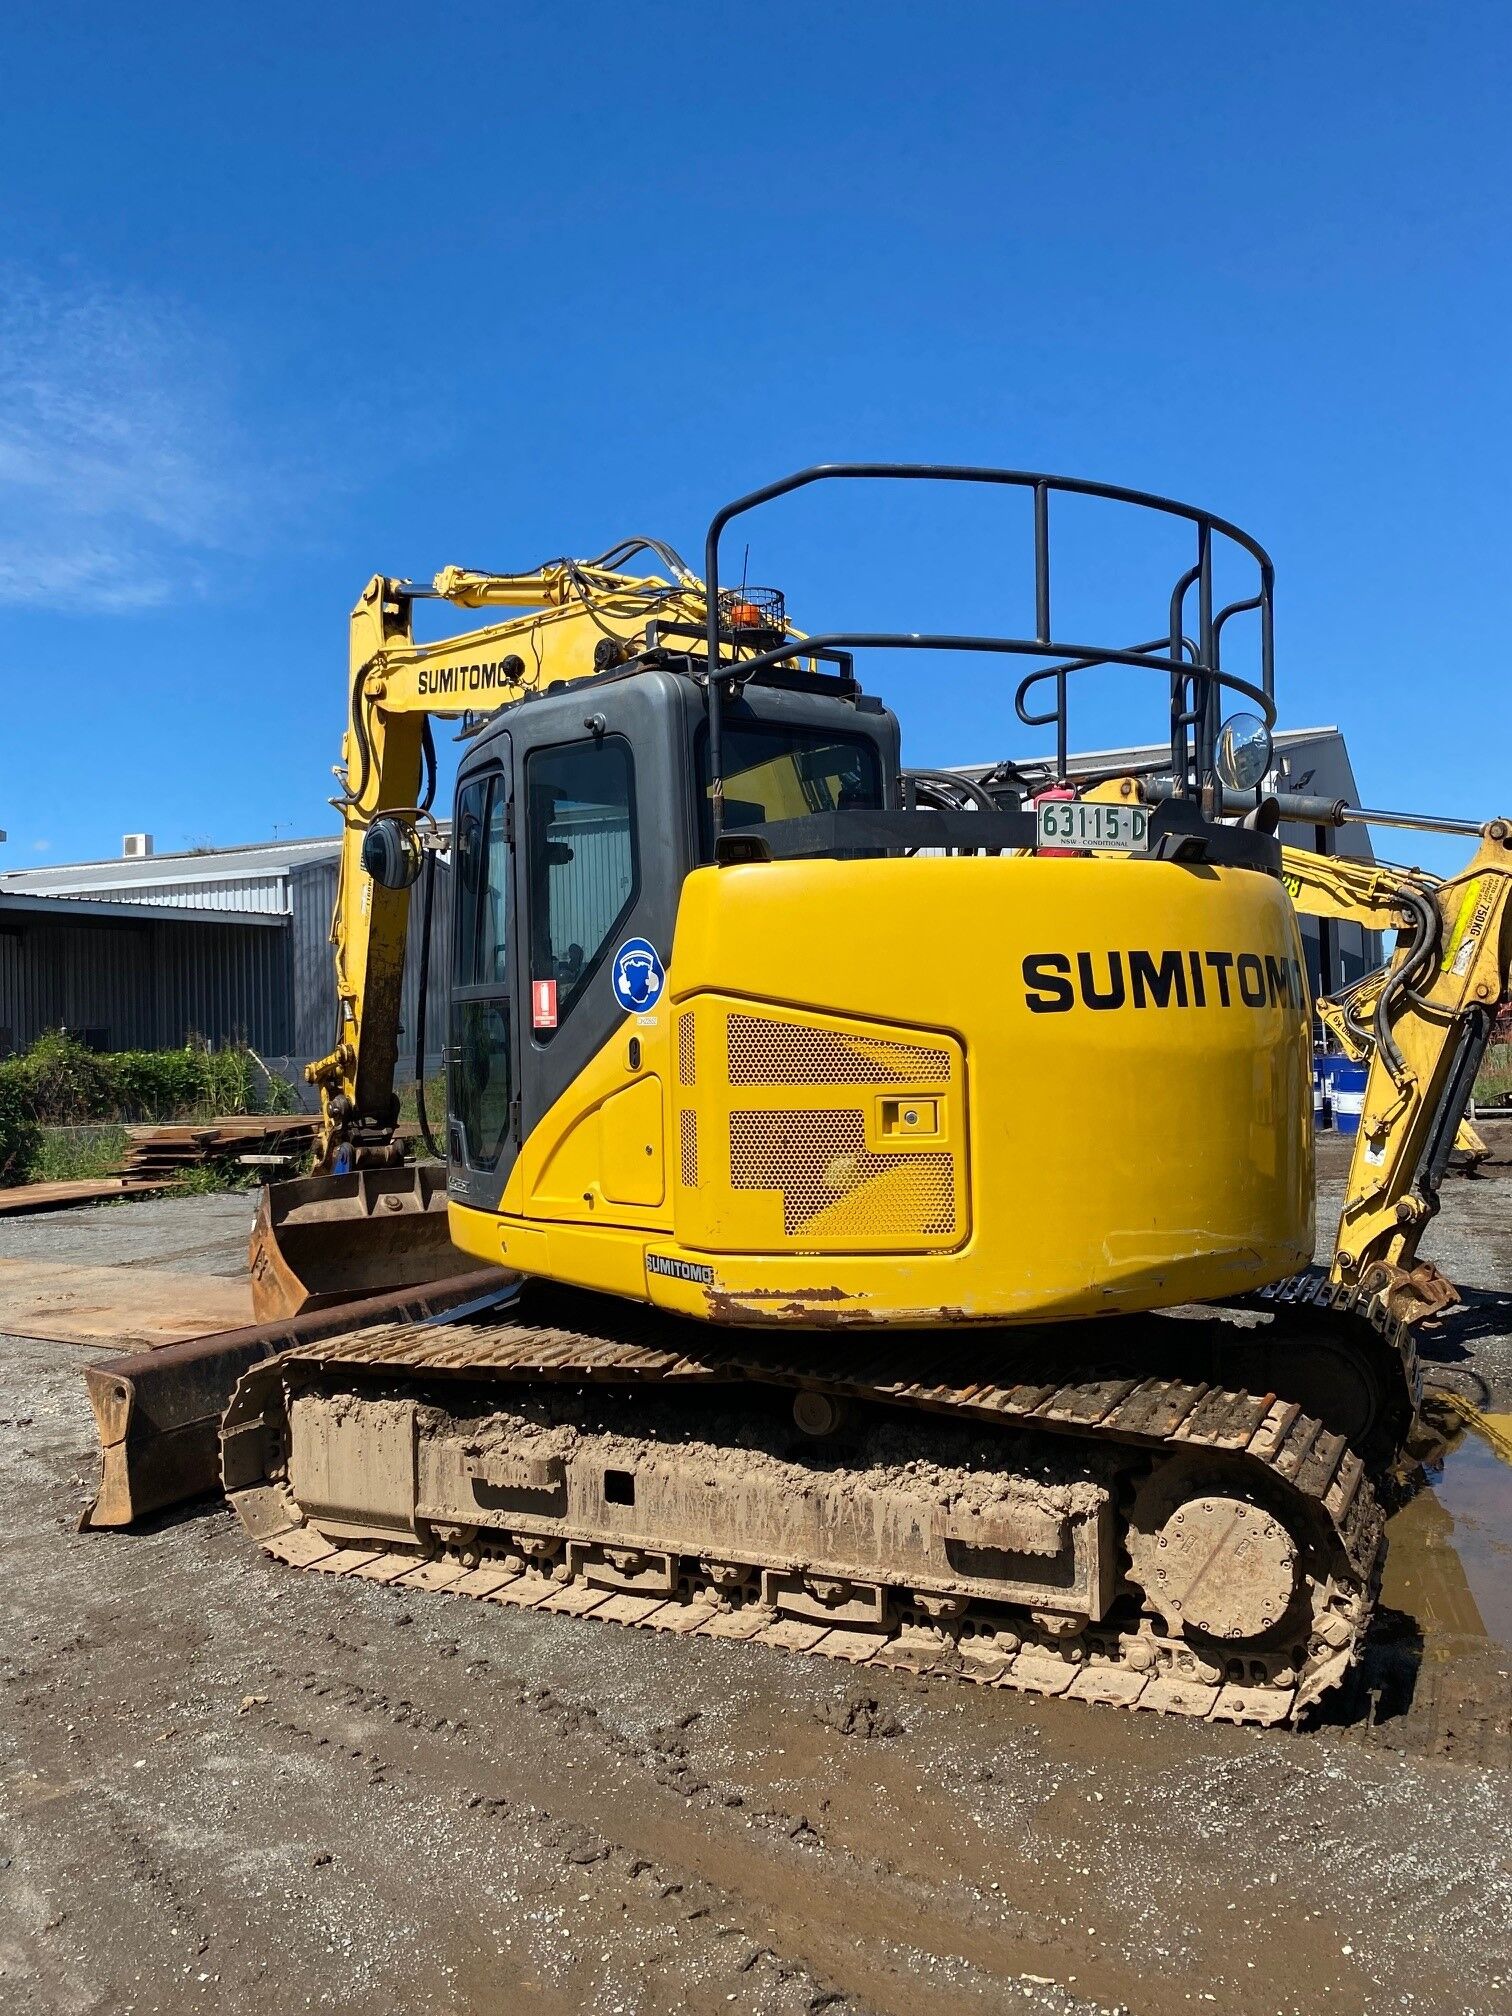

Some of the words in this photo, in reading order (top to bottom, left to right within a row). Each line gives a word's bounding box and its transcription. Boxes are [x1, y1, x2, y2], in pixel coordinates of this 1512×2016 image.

[1082, 839, 1128, 847] CONDITIONAL
[1470, 904, 1490, 936] 750KG
[645, 1255, 711, 1284] SUMITOMO
